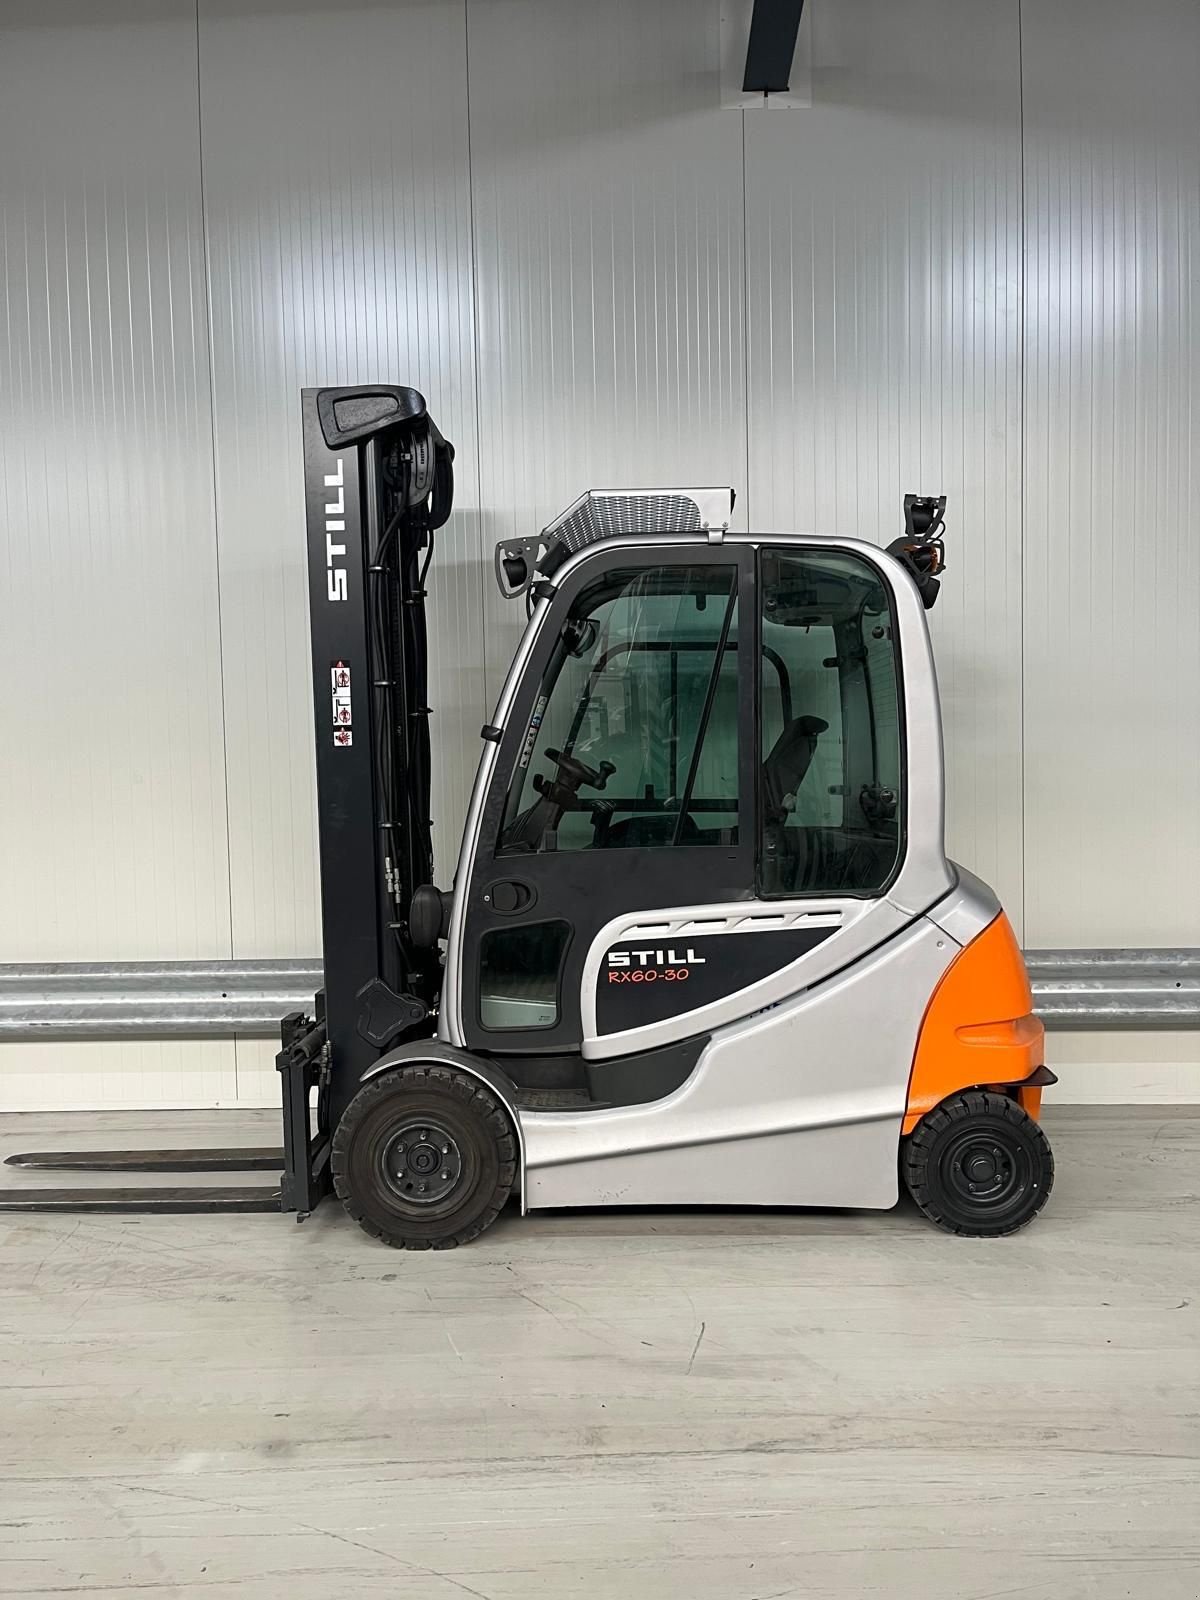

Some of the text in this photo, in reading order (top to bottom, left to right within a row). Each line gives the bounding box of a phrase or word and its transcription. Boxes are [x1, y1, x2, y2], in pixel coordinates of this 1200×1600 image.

[323, 458, 348, 602] STILL
[608, 948, 706, 967] STILL
[608, 968, 690, 984] RX60-30
